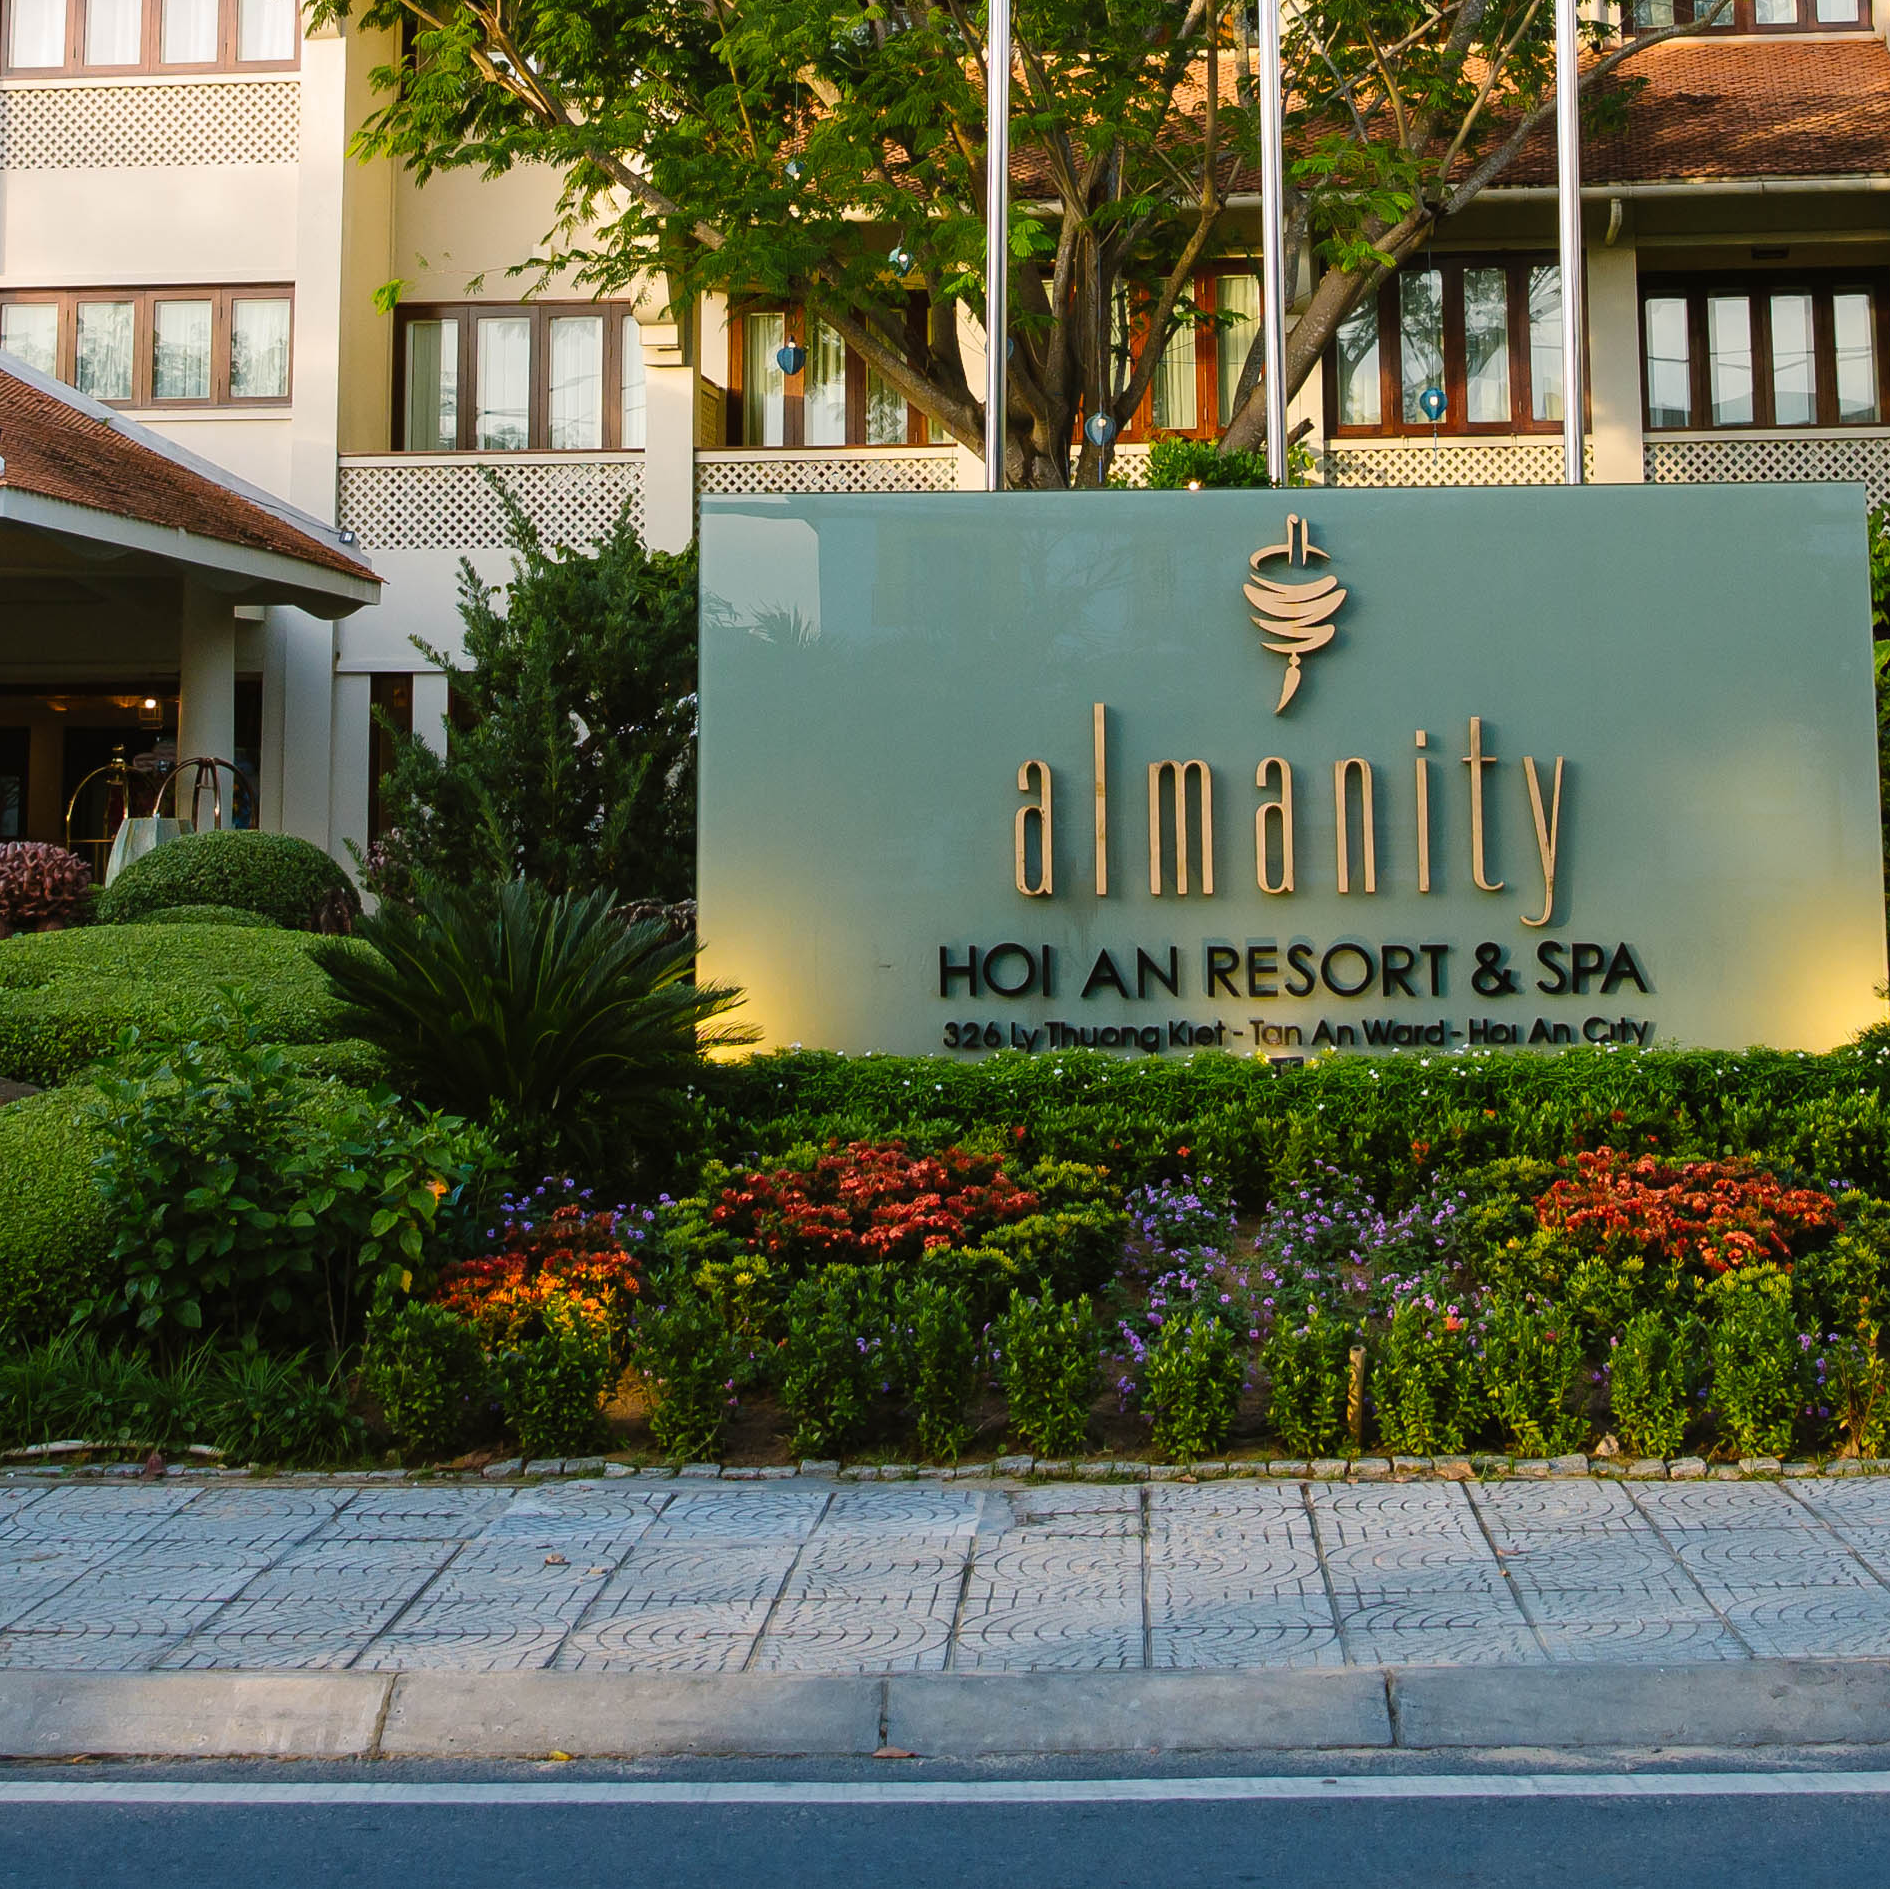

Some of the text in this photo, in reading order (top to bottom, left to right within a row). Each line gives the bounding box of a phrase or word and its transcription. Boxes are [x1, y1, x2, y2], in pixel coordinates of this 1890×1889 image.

[1014, 701, 1565, 927] almanity
[938, 940, 1649, 999] HOI AN RESORT & SPA
[942, 1020, 1002, 1049] 326
[1010, 1021, 1040, 1054] Ly
[1043, 1020, 1161, 1053] Thuong
[1248, 1018, 1303, 1047] Tan
[1310, 1018, 1355, 1047] An
[1361, 1018, 1445, 1046] Ward
[1527, 1017, 1571, 1045] An
